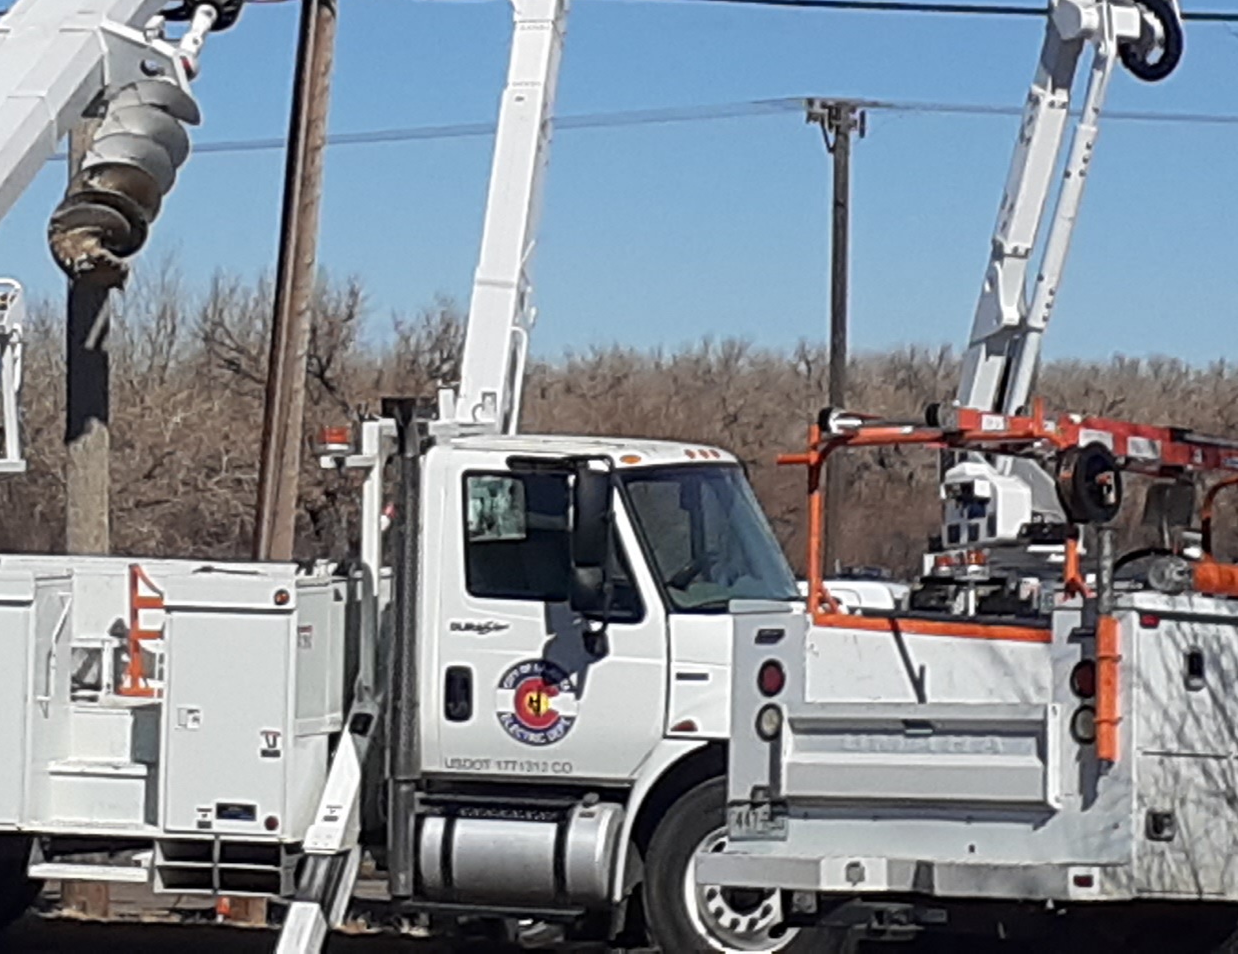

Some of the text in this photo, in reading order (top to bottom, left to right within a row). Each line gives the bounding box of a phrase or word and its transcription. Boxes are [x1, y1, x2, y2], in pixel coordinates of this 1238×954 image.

[500, 713, 546, 743] ELECTRIC
[444, 757, 491, 771] USDOT
[551, 761, 573, 774] CO
